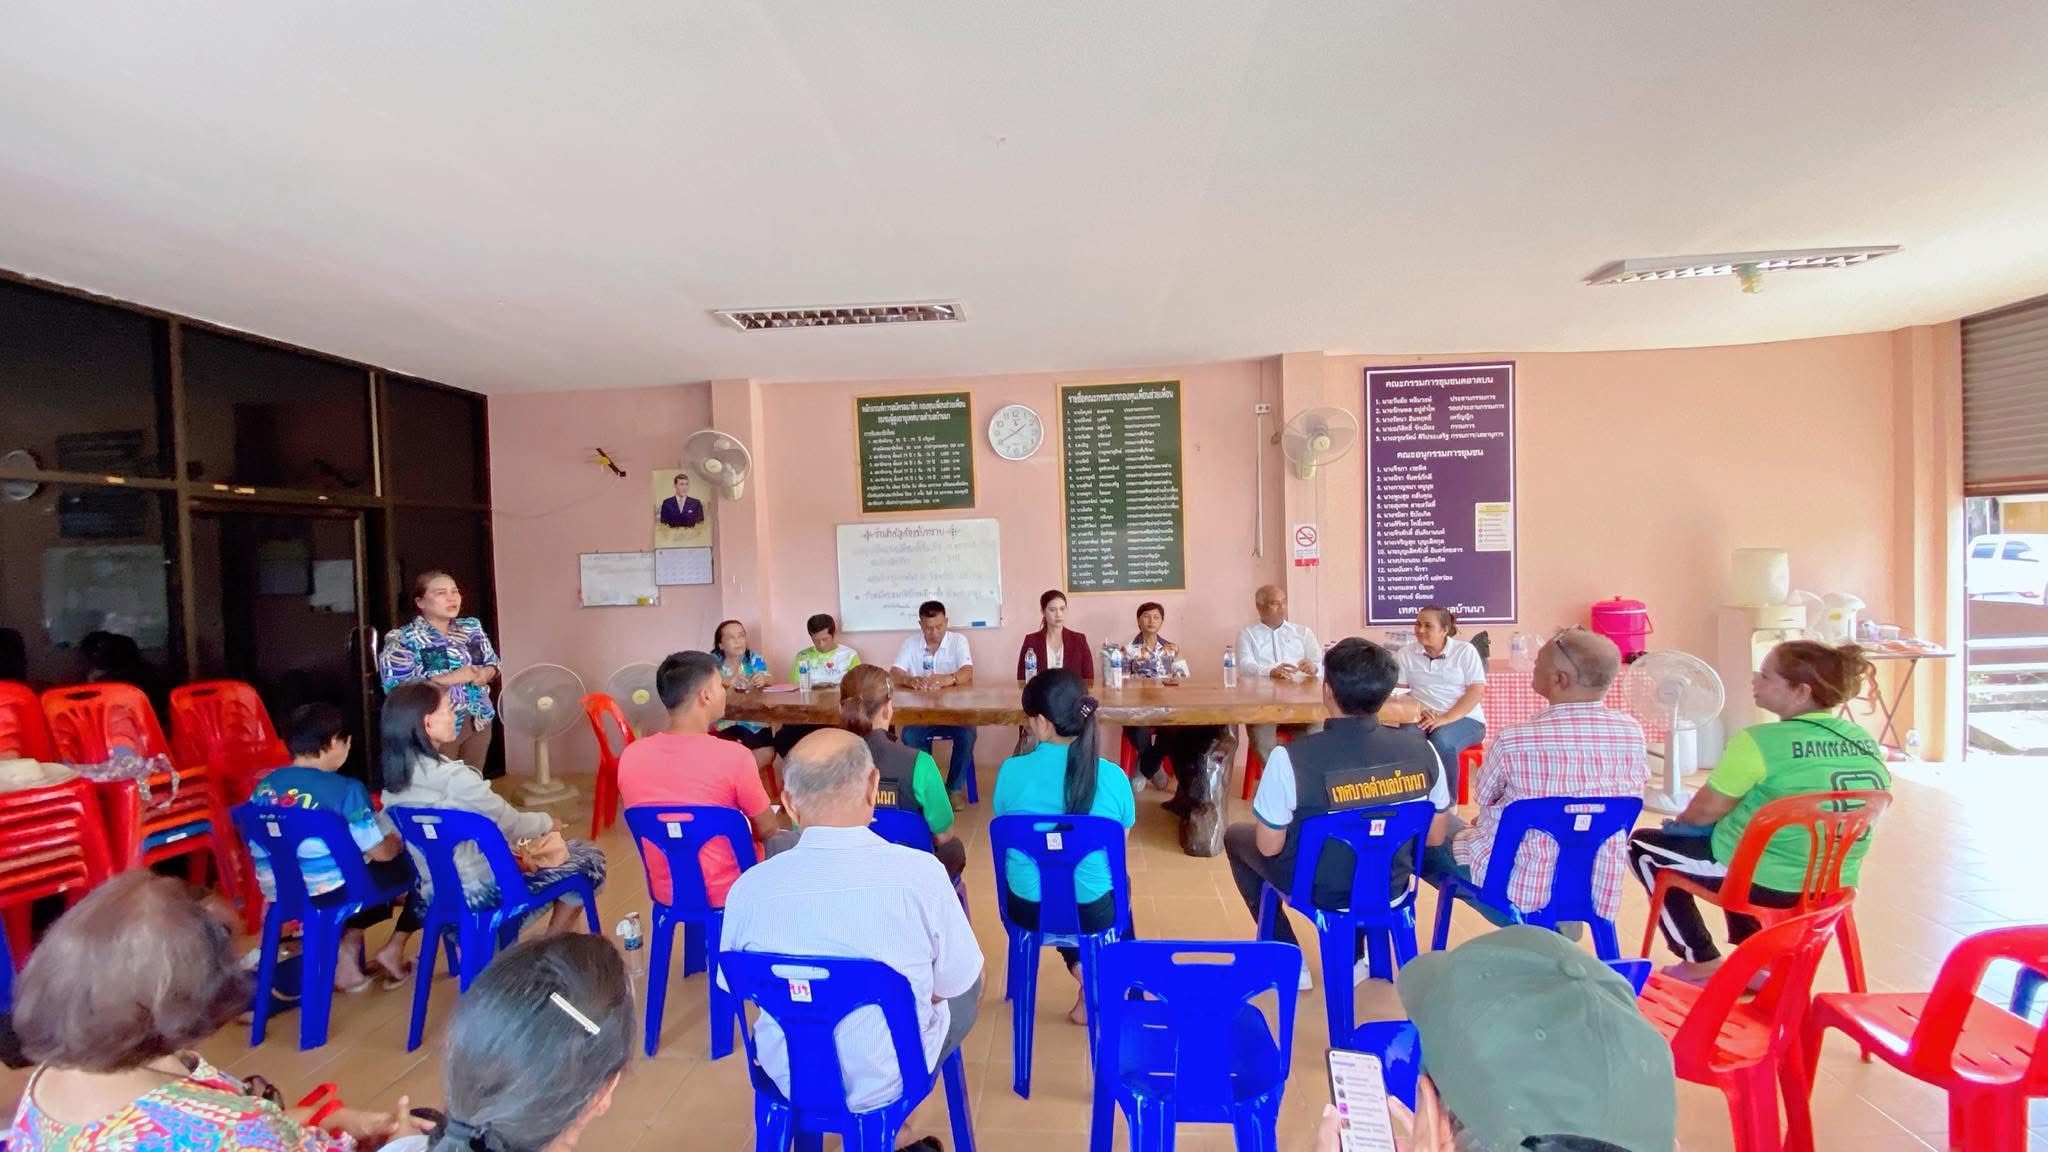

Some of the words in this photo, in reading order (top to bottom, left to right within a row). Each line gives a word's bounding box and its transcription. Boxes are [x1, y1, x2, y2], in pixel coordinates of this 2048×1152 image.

[1331, 769, 1427, 803] เทศบาลตำบลบ้านนา
